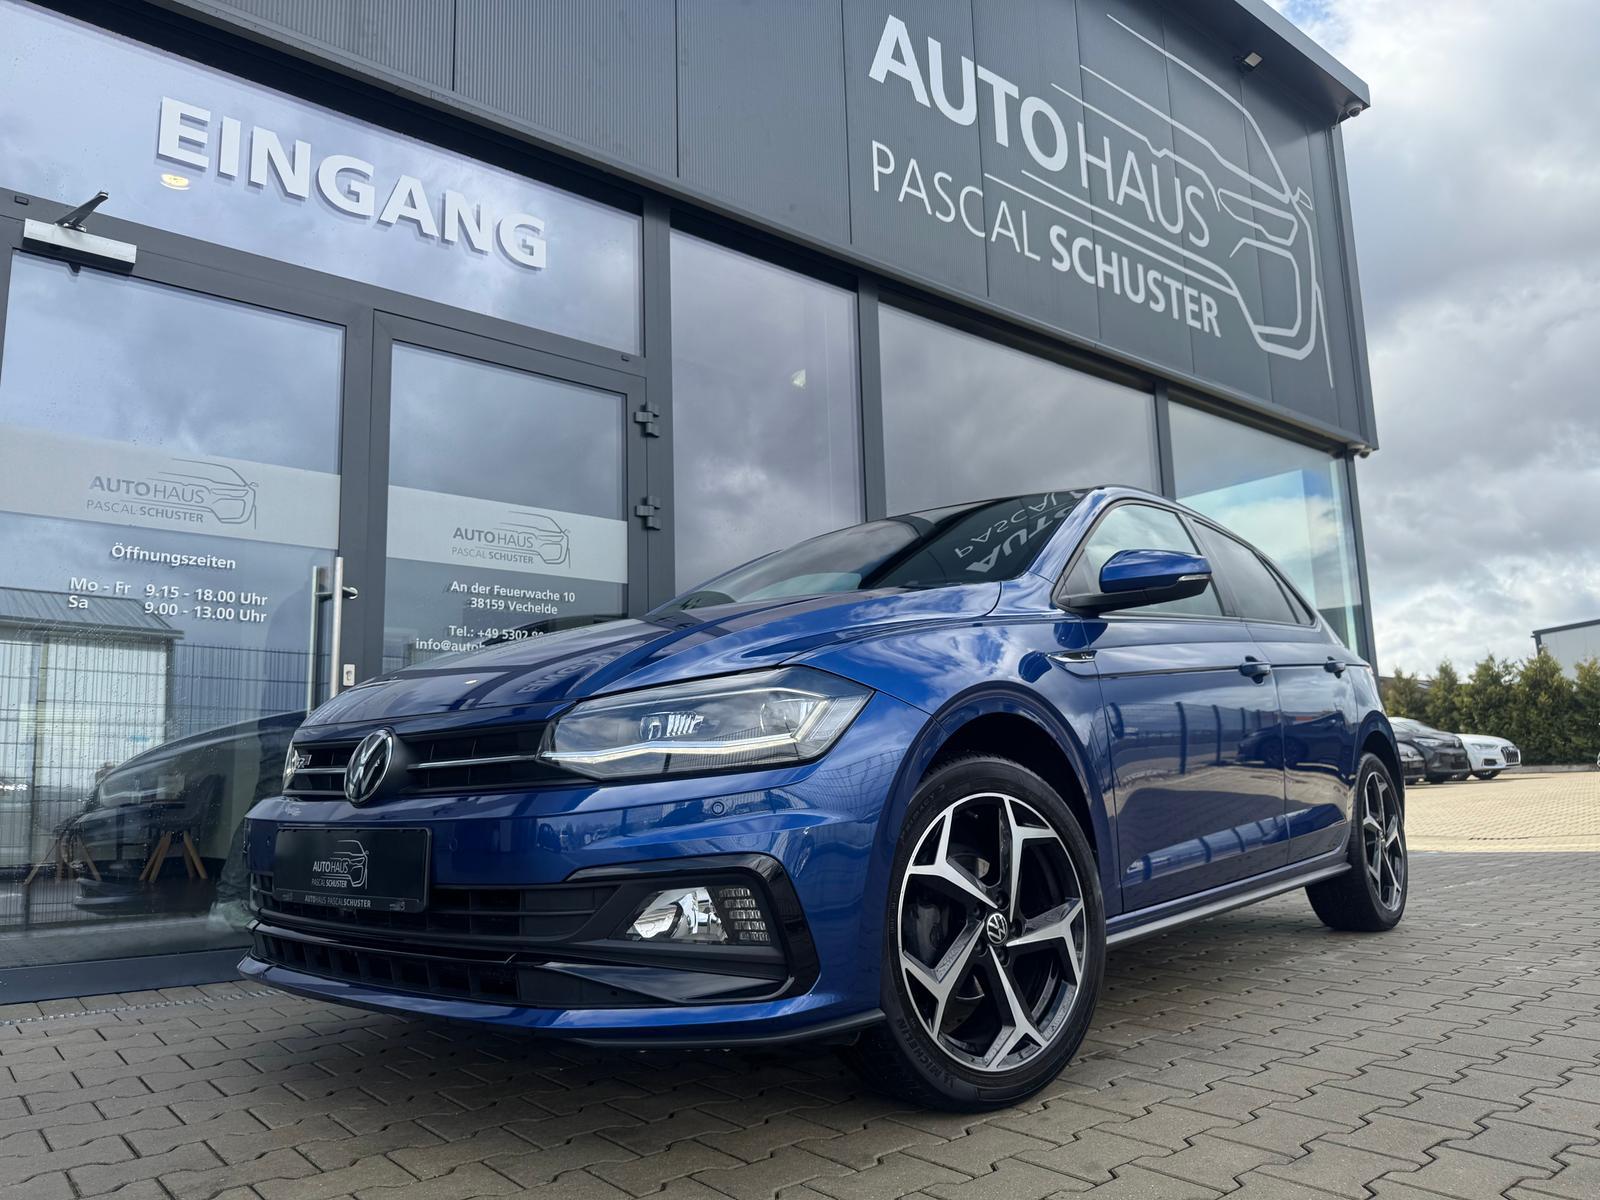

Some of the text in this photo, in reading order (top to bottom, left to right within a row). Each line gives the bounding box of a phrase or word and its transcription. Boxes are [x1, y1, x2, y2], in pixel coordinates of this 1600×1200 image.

[157, 96, 547, 270] EINGANG
[871, 140, 1221, 338] PASCAL SCHUSTER
[86, 500, 204, 523] PASCAL SCHUSTER
[111, 543, 236, 569] Öffnungszeiten
[451, 546, 534, 564] PASCAL SCHUSTER
[70, 577, 98, 592] Mo
[115, 581, 131, 594] Fr
[146, 584, 180, 598] 9.15
[195, 588, 236, 603] 18.00
[240, 592, 268, 606] Uhr
[450, 581, 576, 602] An der Feuerwache 10
[68, 595, 89, 609] Sa
[144, 601, 178, 615] 9.00
[194, 605, 235, 620] 13.00
[239, 609, 267, 622] Uhr
[470, 597, 558, 615] 38159 Vechelde
[449, 625, 474, 638] Tel.:
[477, 628, 499, 640] +49
[502, 629, 529, 640] 5302
[312, 861, 349, 873] AUTOHAUS
[325, 879, 348, 888] SCHUSTER
